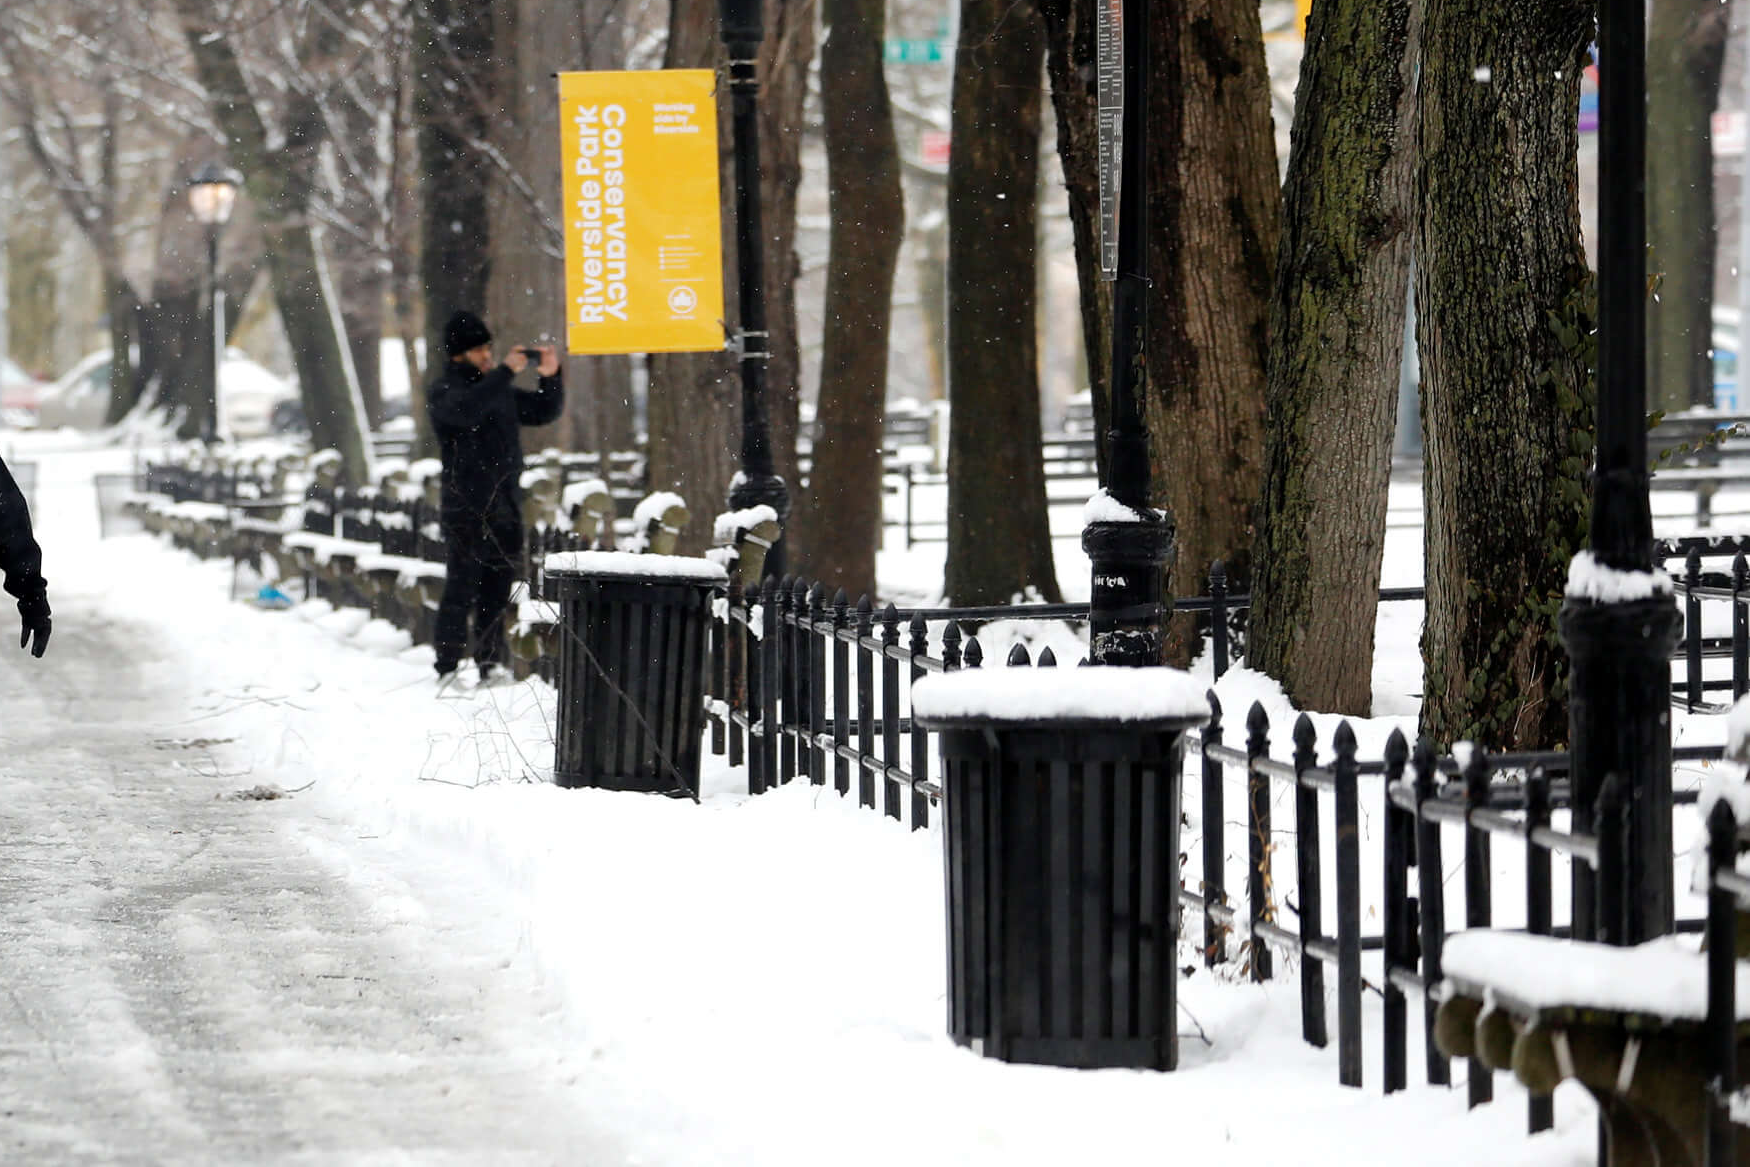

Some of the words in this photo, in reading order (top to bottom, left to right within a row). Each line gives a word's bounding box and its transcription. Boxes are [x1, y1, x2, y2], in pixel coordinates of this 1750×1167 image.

[573, 104, 601, 176] Park
[601, 103, 629, 322] Conservancy
[574, 179, 605, 324] Riverside
